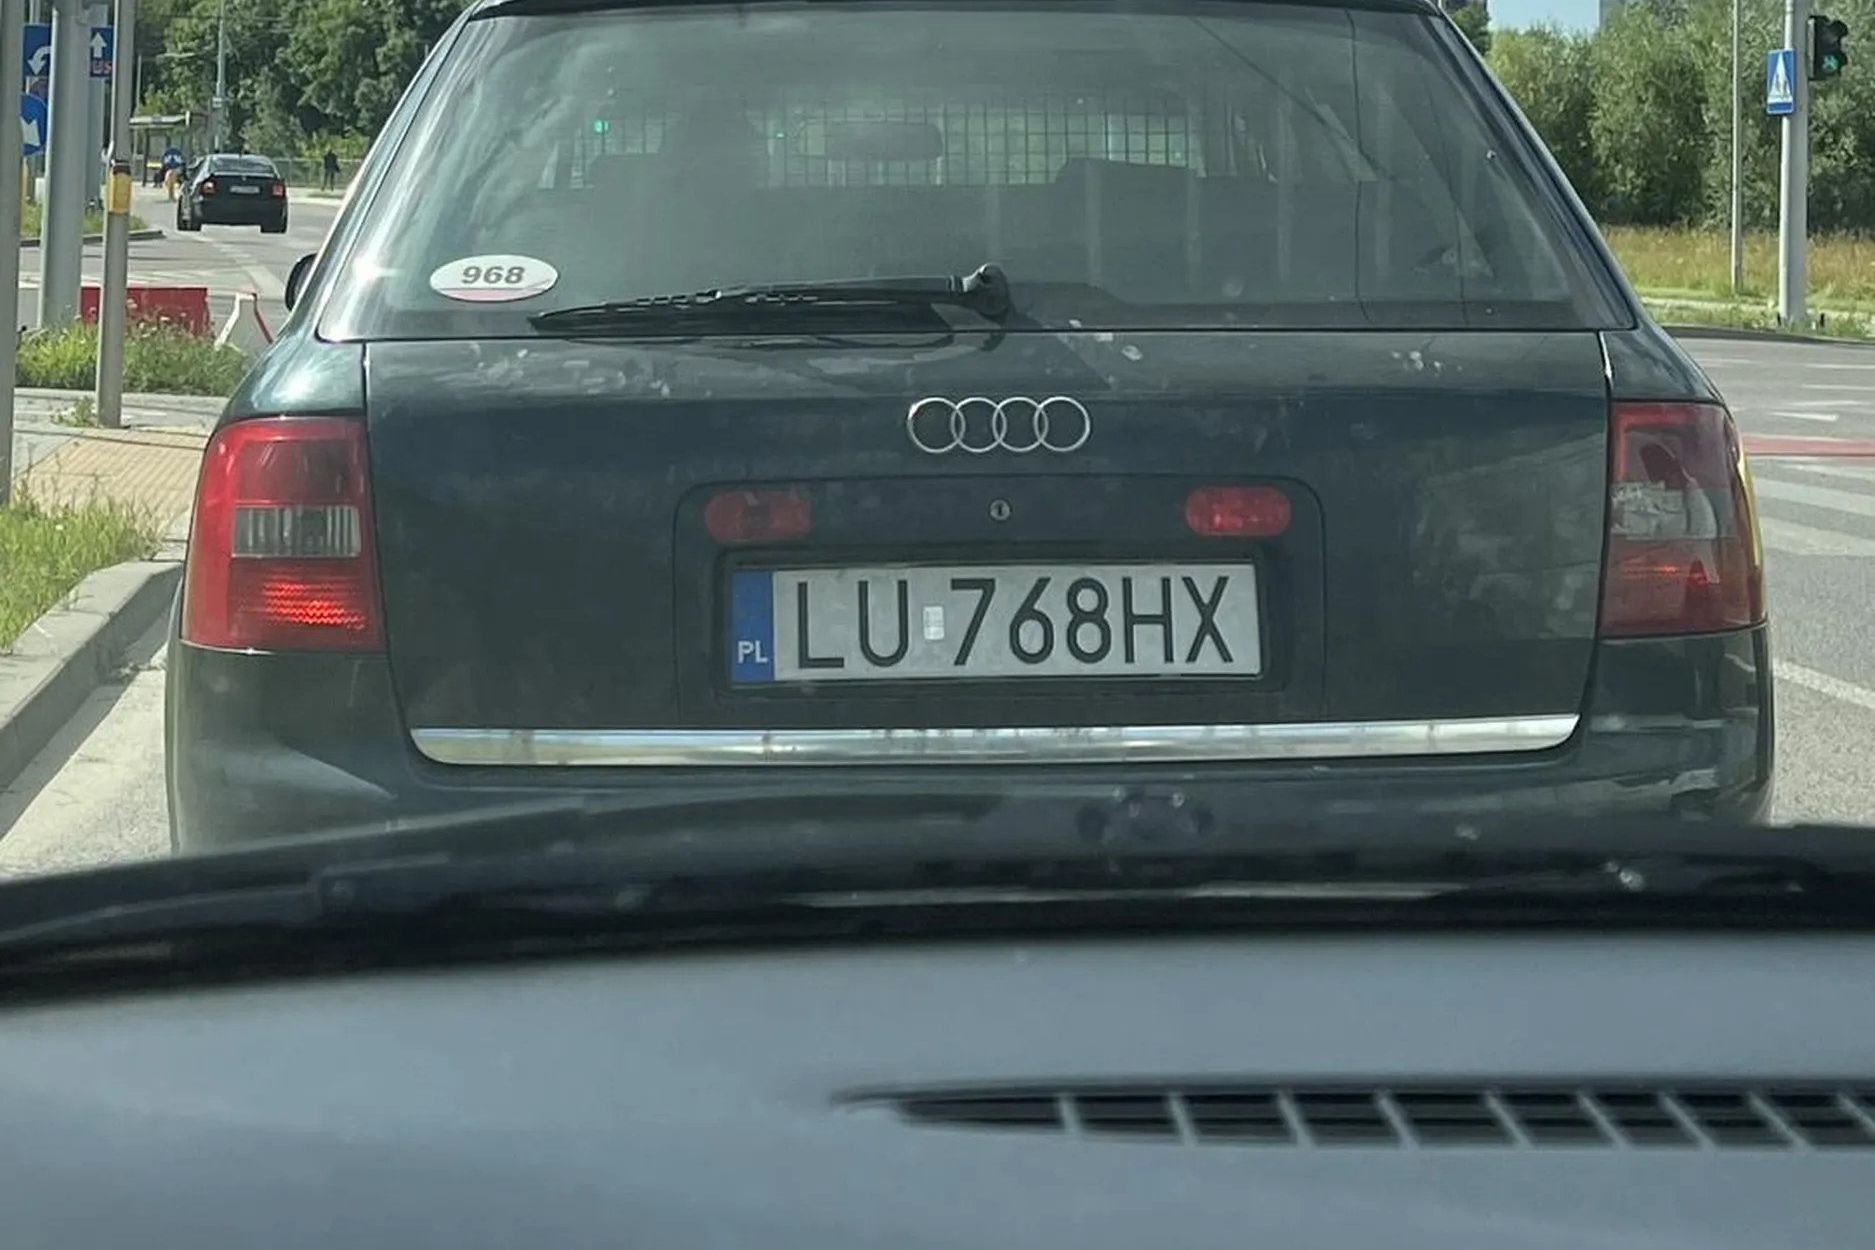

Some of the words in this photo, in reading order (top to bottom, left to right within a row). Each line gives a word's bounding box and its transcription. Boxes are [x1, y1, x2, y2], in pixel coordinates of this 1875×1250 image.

[461, 266, 525, 285] 968
[797, 579, 908, 669] LU
[950, 576, 1234, 667] 768HX
[738, 640, 768, 664] PL
